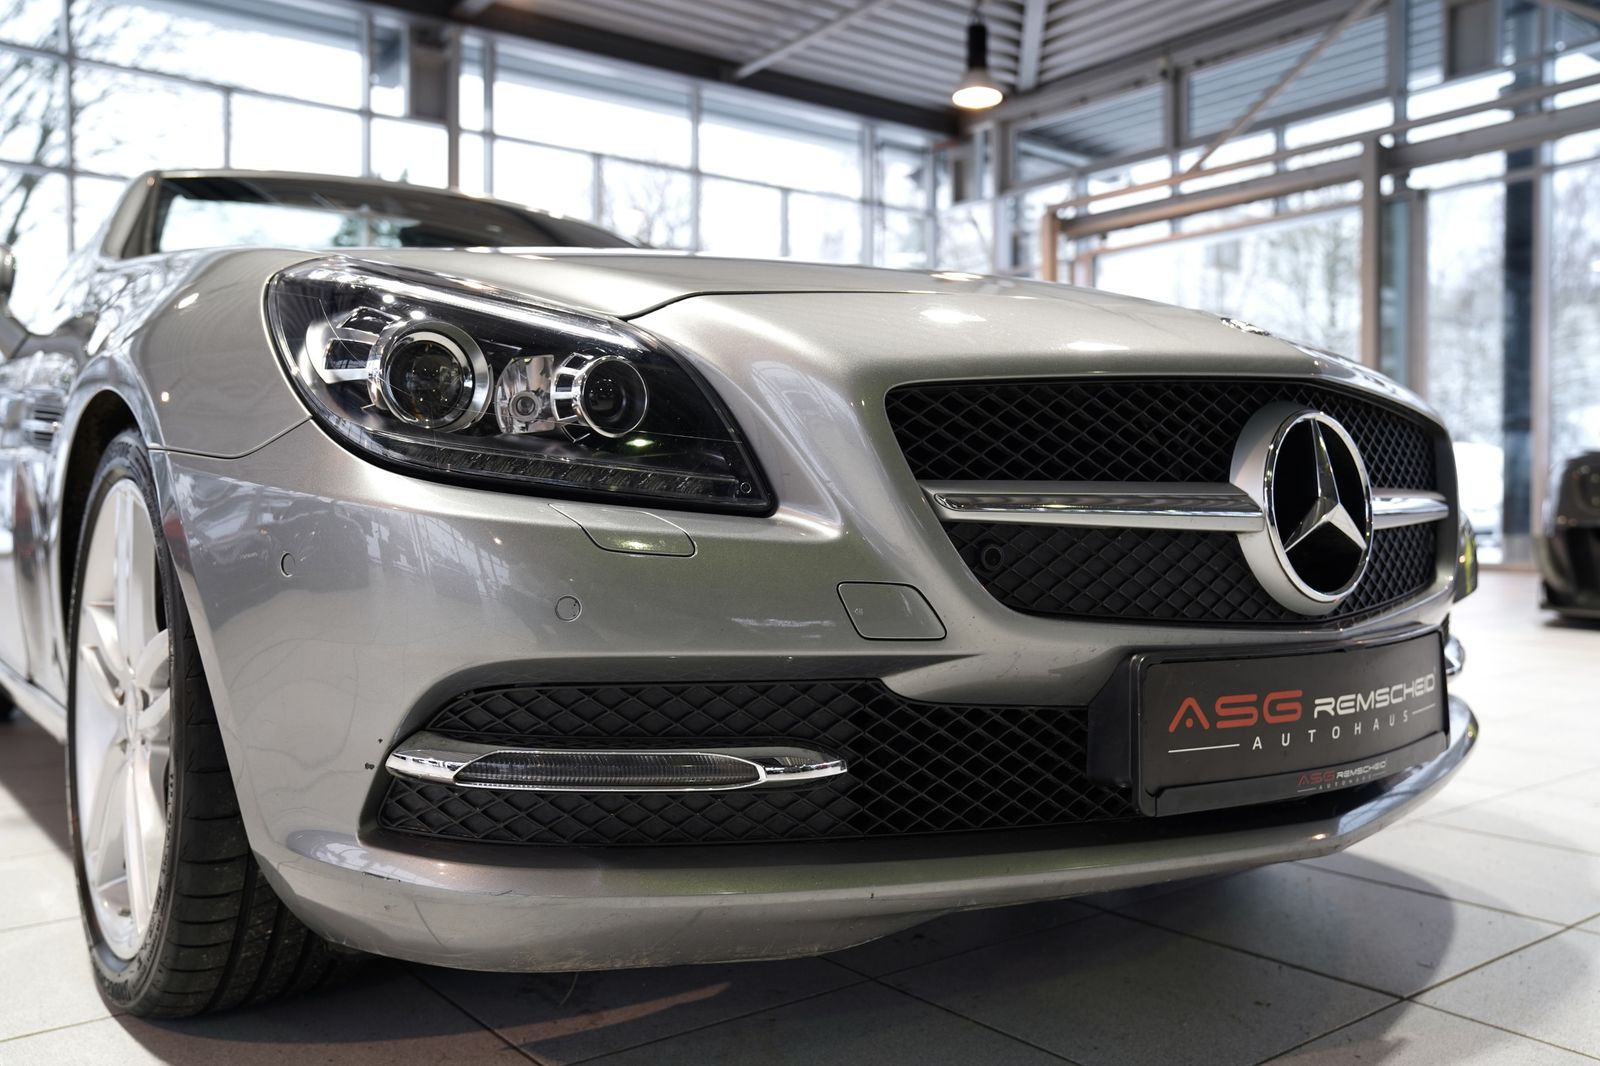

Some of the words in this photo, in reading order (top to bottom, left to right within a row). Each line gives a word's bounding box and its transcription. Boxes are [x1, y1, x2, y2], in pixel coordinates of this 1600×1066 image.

[1168, 690, 1303, 733] ASG
[1314, 673, 1436, 719] REMSCHEID
[1252, 709, 1409, 750] AUTOHAUS
[1297, 768, 1336, 785] ASG
